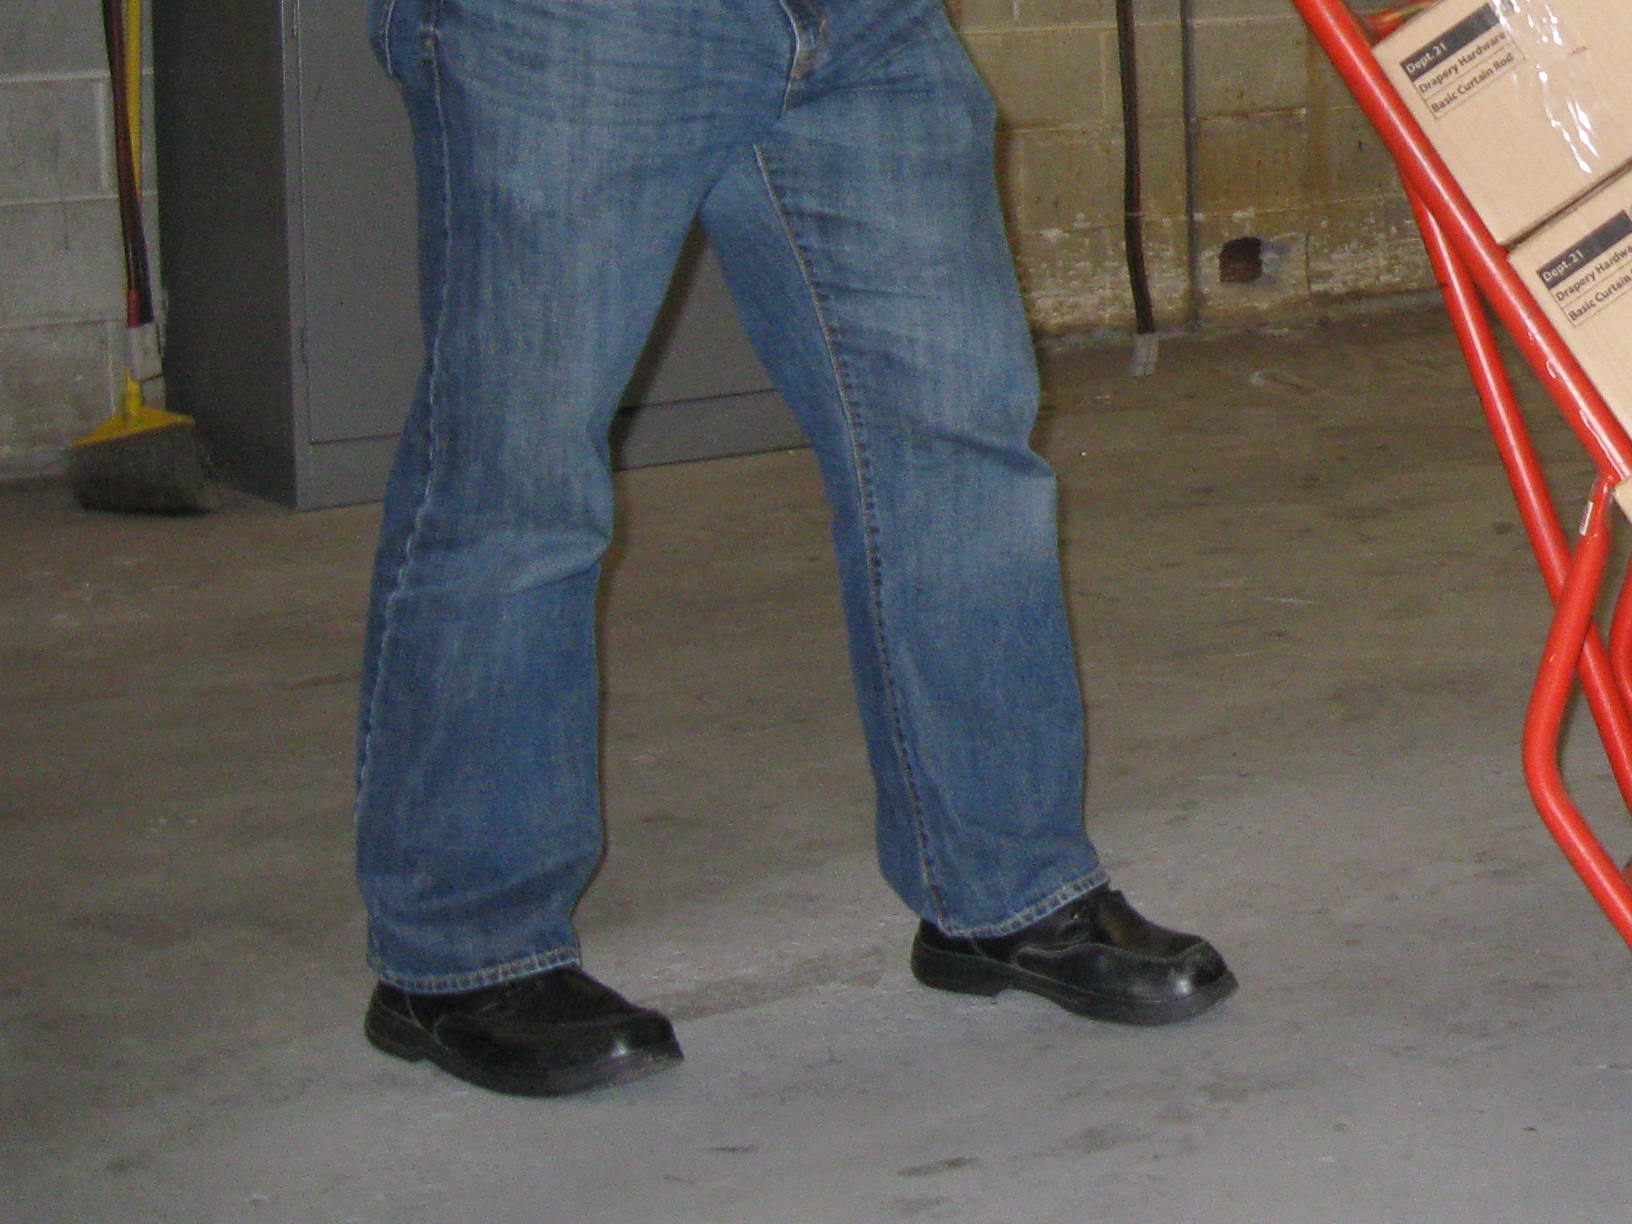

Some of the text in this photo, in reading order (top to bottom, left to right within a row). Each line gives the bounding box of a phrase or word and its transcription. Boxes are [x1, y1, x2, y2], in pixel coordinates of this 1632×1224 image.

[1405, 49, 1435, 75] Dept.
[1418, 31, 1506, 94] Drapery Hardware
[1431, 52, 1514, 113] Basic Curtain Rod
[1541, 259, 1571, 282] Dept.
[1555, 270, 1596, 302] Drapery
[1567, 299, 1596, 322] Basic
[1594, 275, 1632, 302] Curtain
